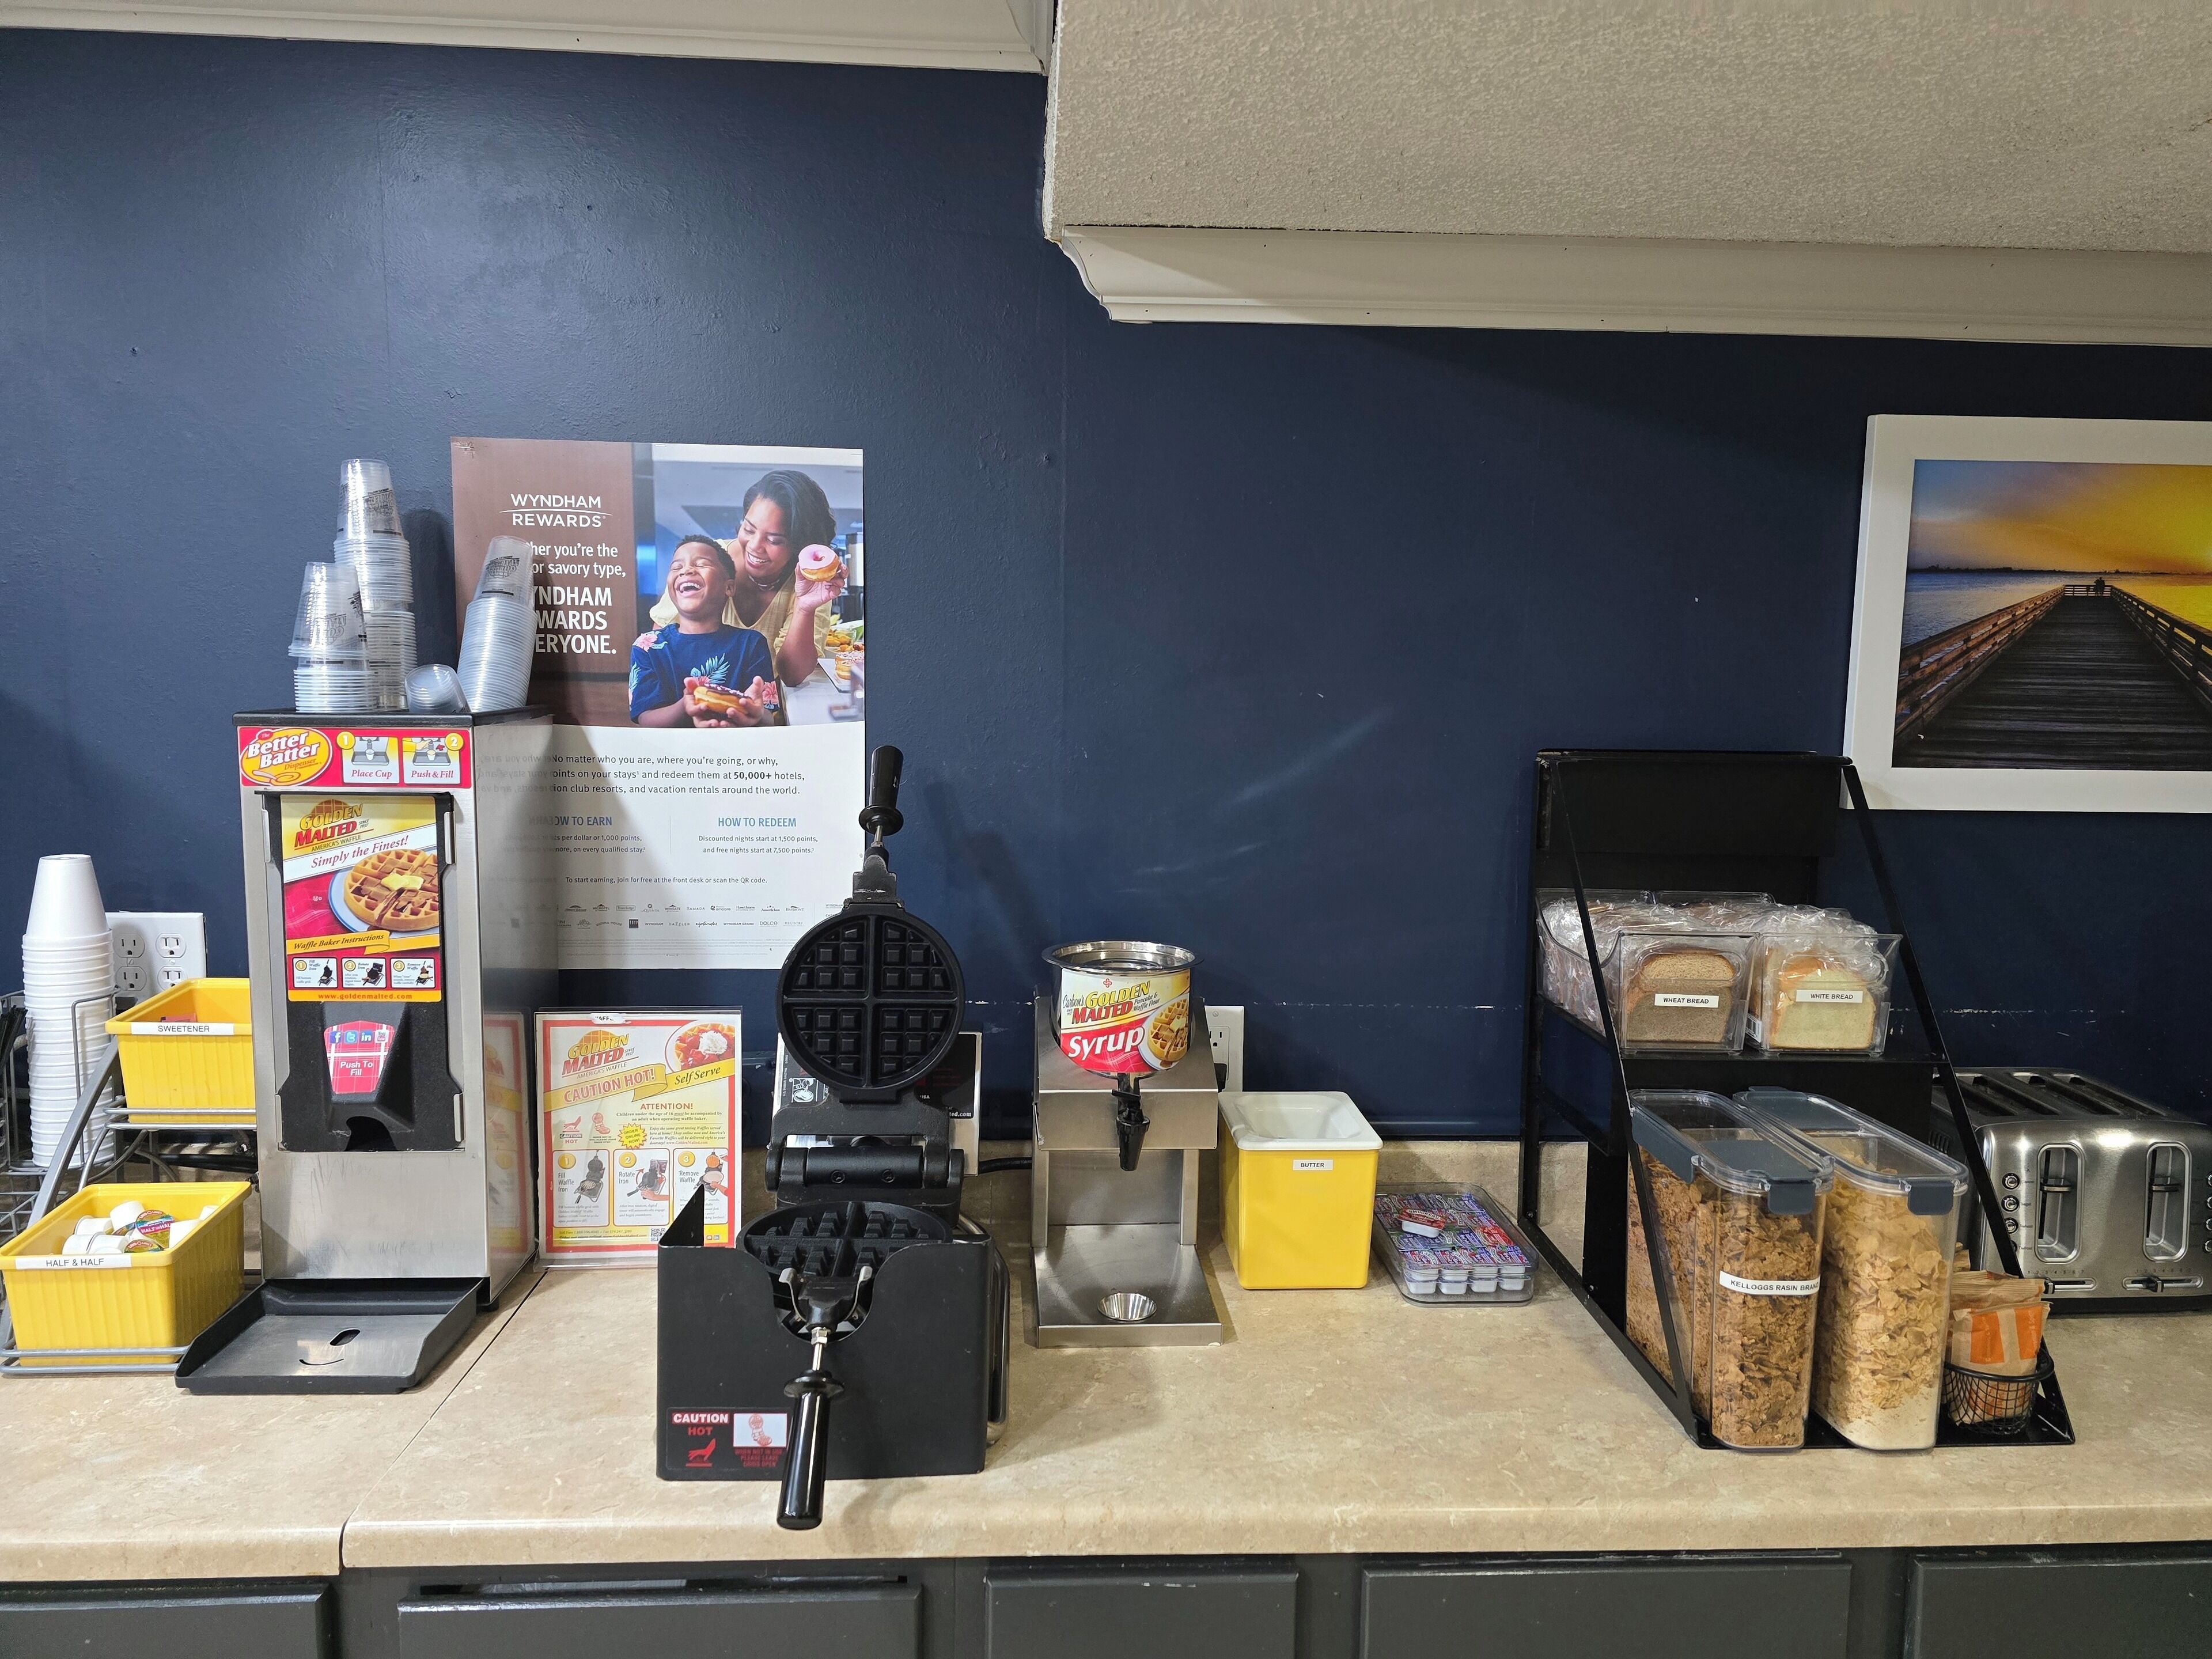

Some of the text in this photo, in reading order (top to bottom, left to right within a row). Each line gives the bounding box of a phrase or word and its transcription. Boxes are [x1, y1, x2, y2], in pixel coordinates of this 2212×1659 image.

[510, 494, 601, 508] WYNDHAM
[513, 513, 601, 528] REWARDS
[597, 543, 618, 557] the
[548, 563, 589, 577] savory
[593, 562, 626, 578] type,
[535, 586, 612, 606] NDHAM
[536, 611, 607, 630] WARDS
[535, 634, 616, 654] ERYONE.
[247, 731, 309, 759] Better
[343, 735, 349, 745] 1
[451, 736, 457, 747] 2
[260, 742, 321, 770] Batter
[619, 757, 634, 765] you
[657, 756, 684, 764] where
[717, 757, 744, 766] going,
[758, 757, 778, 766] why,
[284, 758, 316, 771] Dispenser
[351, 769, 392, 779] Place Cup
[411, 770, 431, 778] Push
[440, 770, 453, 778] Fill
[553, 769, 575, 778] oints
[591, 771, 611, 779] your
[661, 771, 695, 779] redeem
[698, 771, 719, 779] them
[734, 772, 772, 781] 50,000+
[775, 772, 804, 781] hotels,
[570, 785, 589, 793] club
[592, 786, 626, 794] resorts,
[648, 785, 686, 793] vacation
[689, 786, 719, 794] rentals
[772, 786, 800, 794] world.
[300, 804, 363, 831] GOLDEN
[555, 816, 612, 826] OW TO EARN
[718, 817, 796, 827] HOW TO REDEEM
[294, 820, 357, 847] MALTED
[340, 834, 362, 846] WAFFLE
[311, 835, 409, 869] Simply the Finest!
[294, 933, 384, 949] Waffle Baker Instructions
[1086, 980, 1150, 1009] GOLDEN
[1134, 995, 1153, 1005] Pancake
[1133, 998, 1160, 1012] Waffle Flour
[1072, 1001, 1133, 1025] MALTED
[568, 1033, 629, 1059] GOLDEN
[1069, 1027, 1145, 1060] Syrup
[562, 1047, 624, 1075] MALTED
[605, 1062, 627, 1072] WAFFLE
[675, 1066, 721, 1085] Self Serve
[564, 1069, 656, 1104] CAUTION HOT!
[81, 1258, 104, 1266] HALF
[1730, 1280, 1774, 1290] KELLOGGS
[673, 1413, 729, 1423] CAUTION
[688, 1427, 713, 1435] HOT
